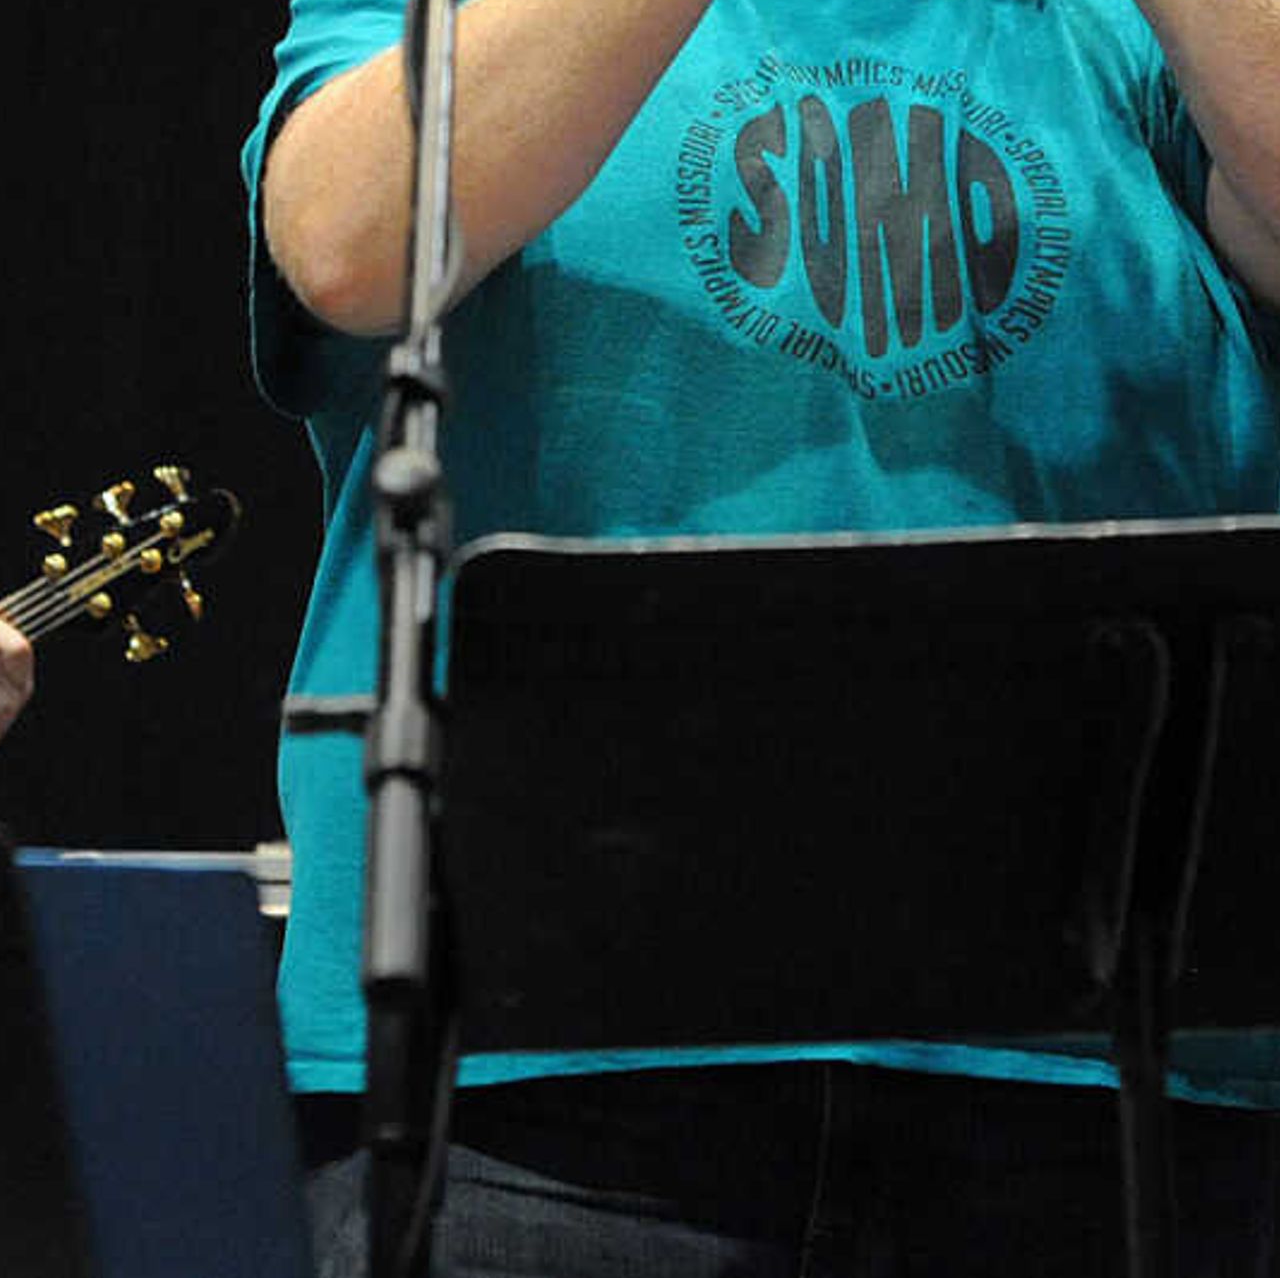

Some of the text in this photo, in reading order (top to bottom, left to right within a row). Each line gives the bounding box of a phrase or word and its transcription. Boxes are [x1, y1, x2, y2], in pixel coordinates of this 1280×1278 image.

[677, 118, 726, 227] MISSOURI
[728, 94, 1021, 358] SOMO
[1004, 138, 1069, 220] SPECIAL
[683, 233, 782, 345] OLYMPICS
[998, 225, 1071, 344] OLYMPICS
